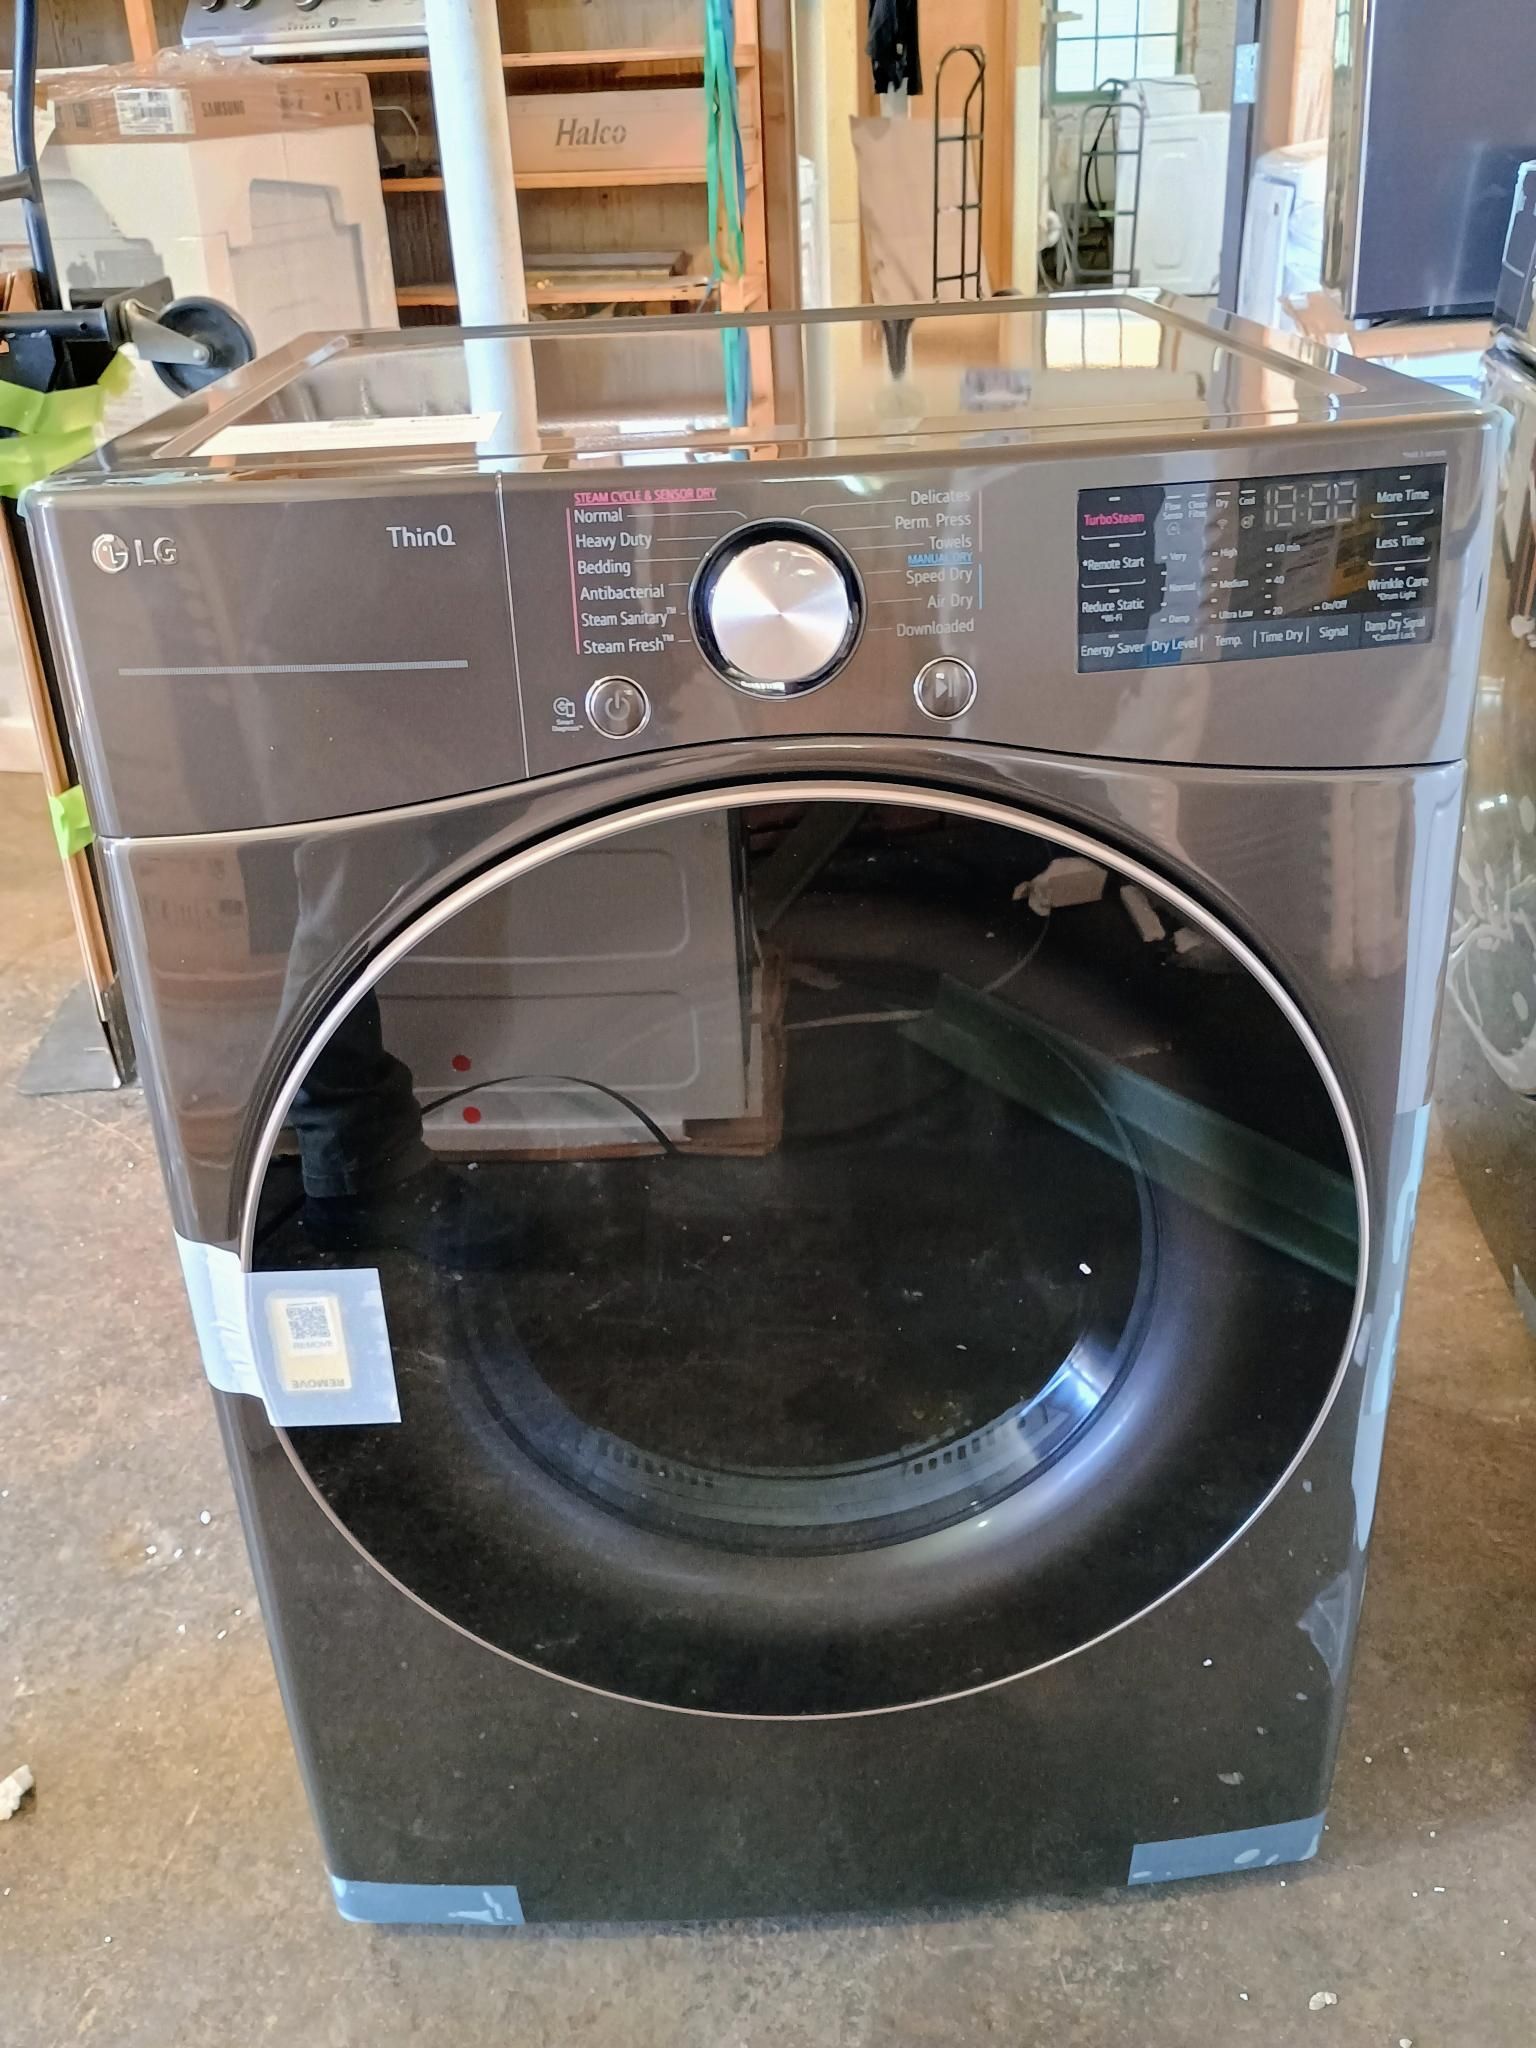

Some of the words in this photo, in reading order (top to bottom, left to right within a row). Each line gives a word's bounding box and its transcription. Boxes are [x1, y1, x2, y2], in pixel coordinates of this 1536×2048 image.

[555, 117, 627, 146] Halco
[574, 492, 609, 504] STEAM
[610, 490, 641, 502] CYCLE
[644, 489, 652, 500] &
[654, 488, 694, 501] SENSOR
[696, 487, 717, 499] DRY
[910, 489, 970, 506] Delicates
[1376, 491, 1403, 504] More
[1405, 489, 1430, 501] Time
[574, 507, 623, 523] Normal
[895, 515, 932, 530] Perm.
[936, 512, 972, 527] Press
[1083, 512, 1145, 526] TurboSteam
[386, 524, 456, 548] ThinQ
[575, 533, 617, 551] Heavy
[619, 532, 652, 549] Duty
[928, 533, 973, 551] Towels
[1375, 537, 1399, 549] Less
[1401, 535, 1425, 547] Time
[135, 537, 178, 567] LG
[1274, 543, 1286, 553] 60
[577, 560, 631, 577] Bedding
[1122, 557, 1145, 569] Start
[906, 569, 945, 587] Speed
[950, 567, 973, 584] Dry
[1273, 575, 1285, 585] 40
[1405, 575, 1430, 588] Care
[580, 583, 665, 600] Antibacterial
[927, 594, 946, 609] Air
[951, 593, 974, 610] Dry
[1081, 600, 1115, 614] Reduce
[1117, 598, 1145, 611] Static
[581, 612, 618, 627] Steam
[1272, 606, 1284, 616] 20
[896, 617, 975, 637] Downloaded
[1260, 630, 1284, 643] Time
[1285, 628, 1304, 643] Dry
[1319, 624, 1349, 641] Signal
[583, 639, 625, 655] Steam
[1080, 644, 1116, 659] Energy
[1117, 641, 1145, 655] Saver
[1151, 639, 1171, 655] Dry
[1171, 636, 1199, 652] Level
